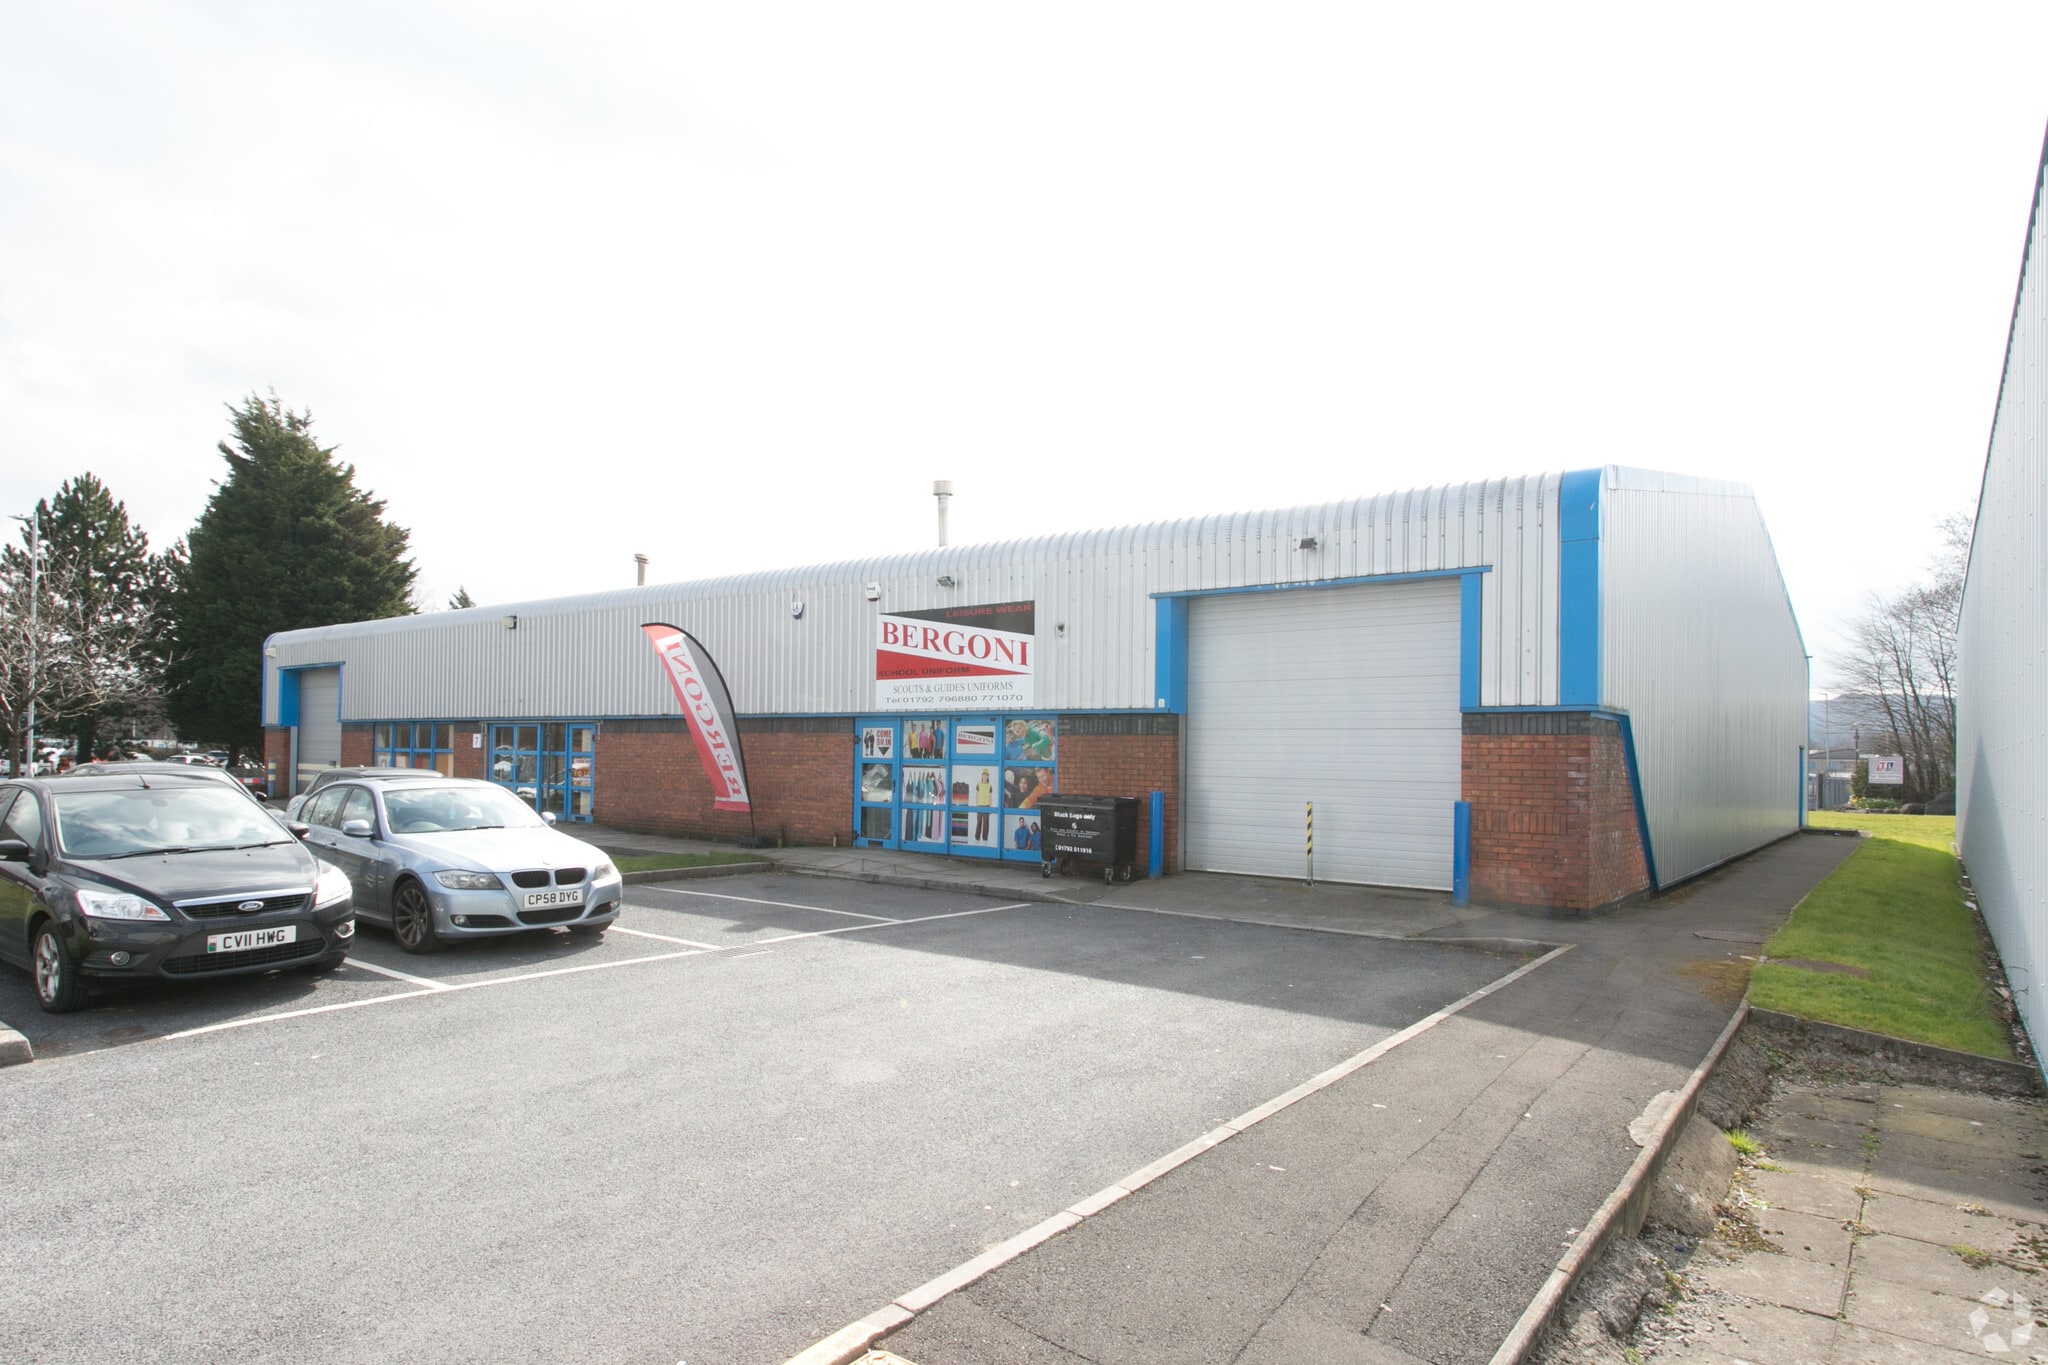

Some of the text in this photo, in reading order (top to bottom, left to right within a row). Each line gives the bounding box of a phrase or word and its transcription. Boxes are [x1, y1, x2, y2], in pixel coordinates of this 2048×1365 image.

[945, 604, 1032, 619] LEISURE WEAR
[881, 621, 1030, 667] BERGONI
[878, 666, 970, 677] SCHOOL UNIFORM
[893, 681, 1014, 694] SCOUTS & GUIDES UNIFORMS
[938, 695, 978, 703] 796880
[981, 694, 1023, 702] 771070
[876, 729, 891, 737] COME
[1083, 813, 1096, 821] only
[528, 890, 578, 905] CP58 DYG
[223, 933, 252, 949] CV11
[256, 929, 285, 945] HWG
